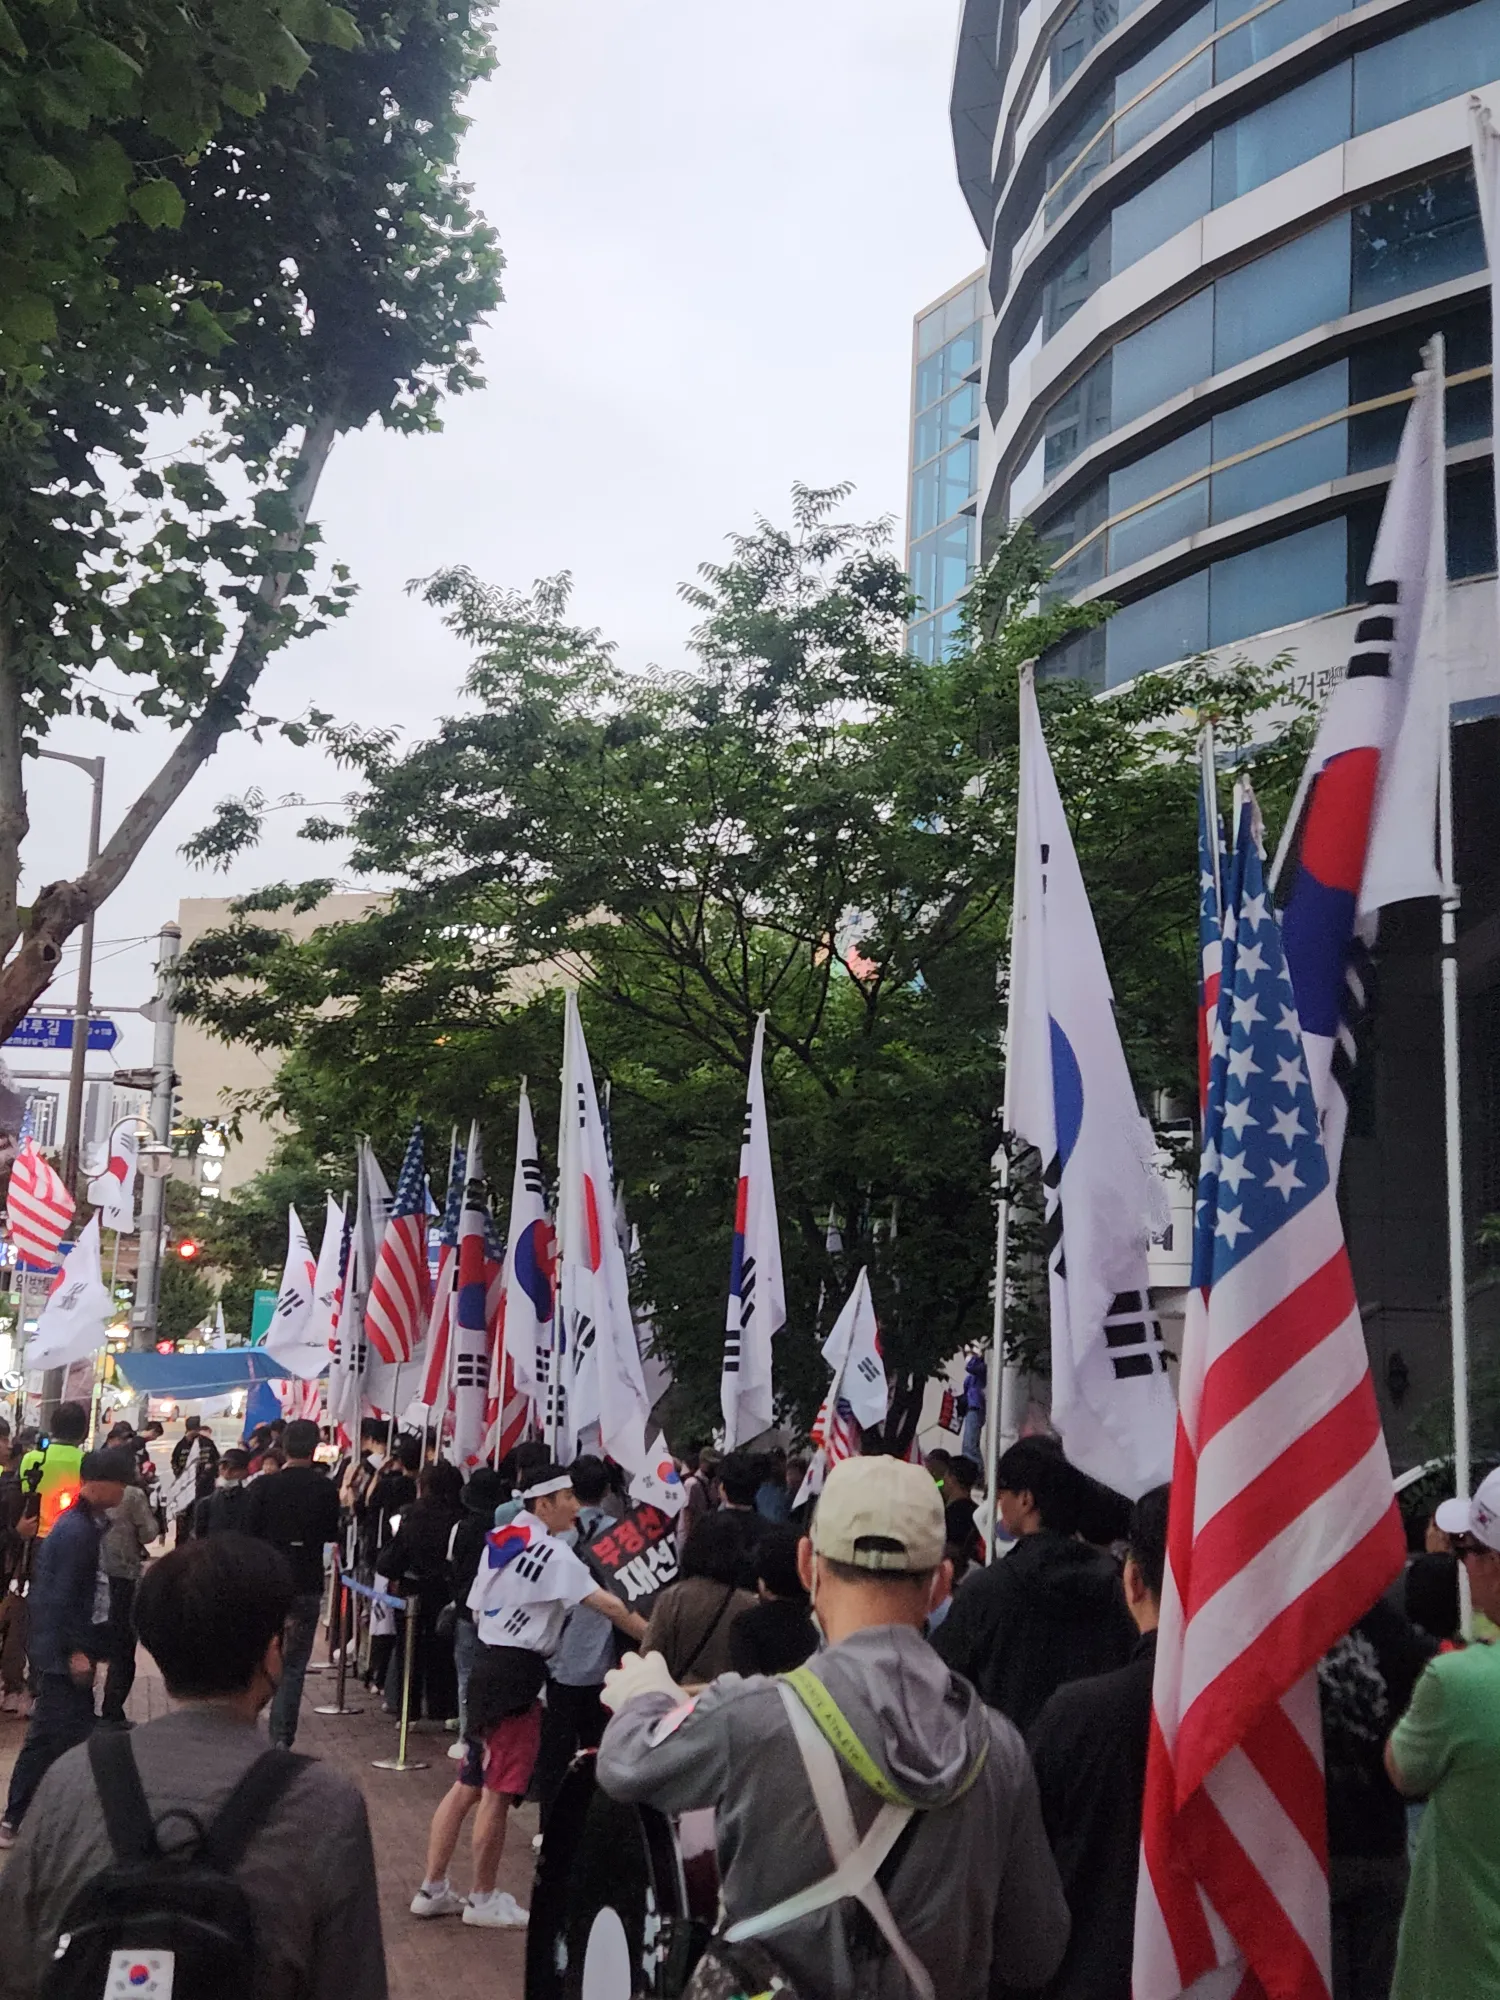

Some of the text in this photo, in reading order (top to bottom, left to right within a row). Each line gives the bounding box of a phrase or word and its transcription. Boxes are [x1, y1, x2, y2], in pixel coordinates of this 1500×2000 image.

[4, 1036, 57, 1047] emaru-gil
[15, 1018, 61, 1036] 마루길
[591, 1507, 665, 1568] 부정선
[613, 1531, 679, 1602] 재선
